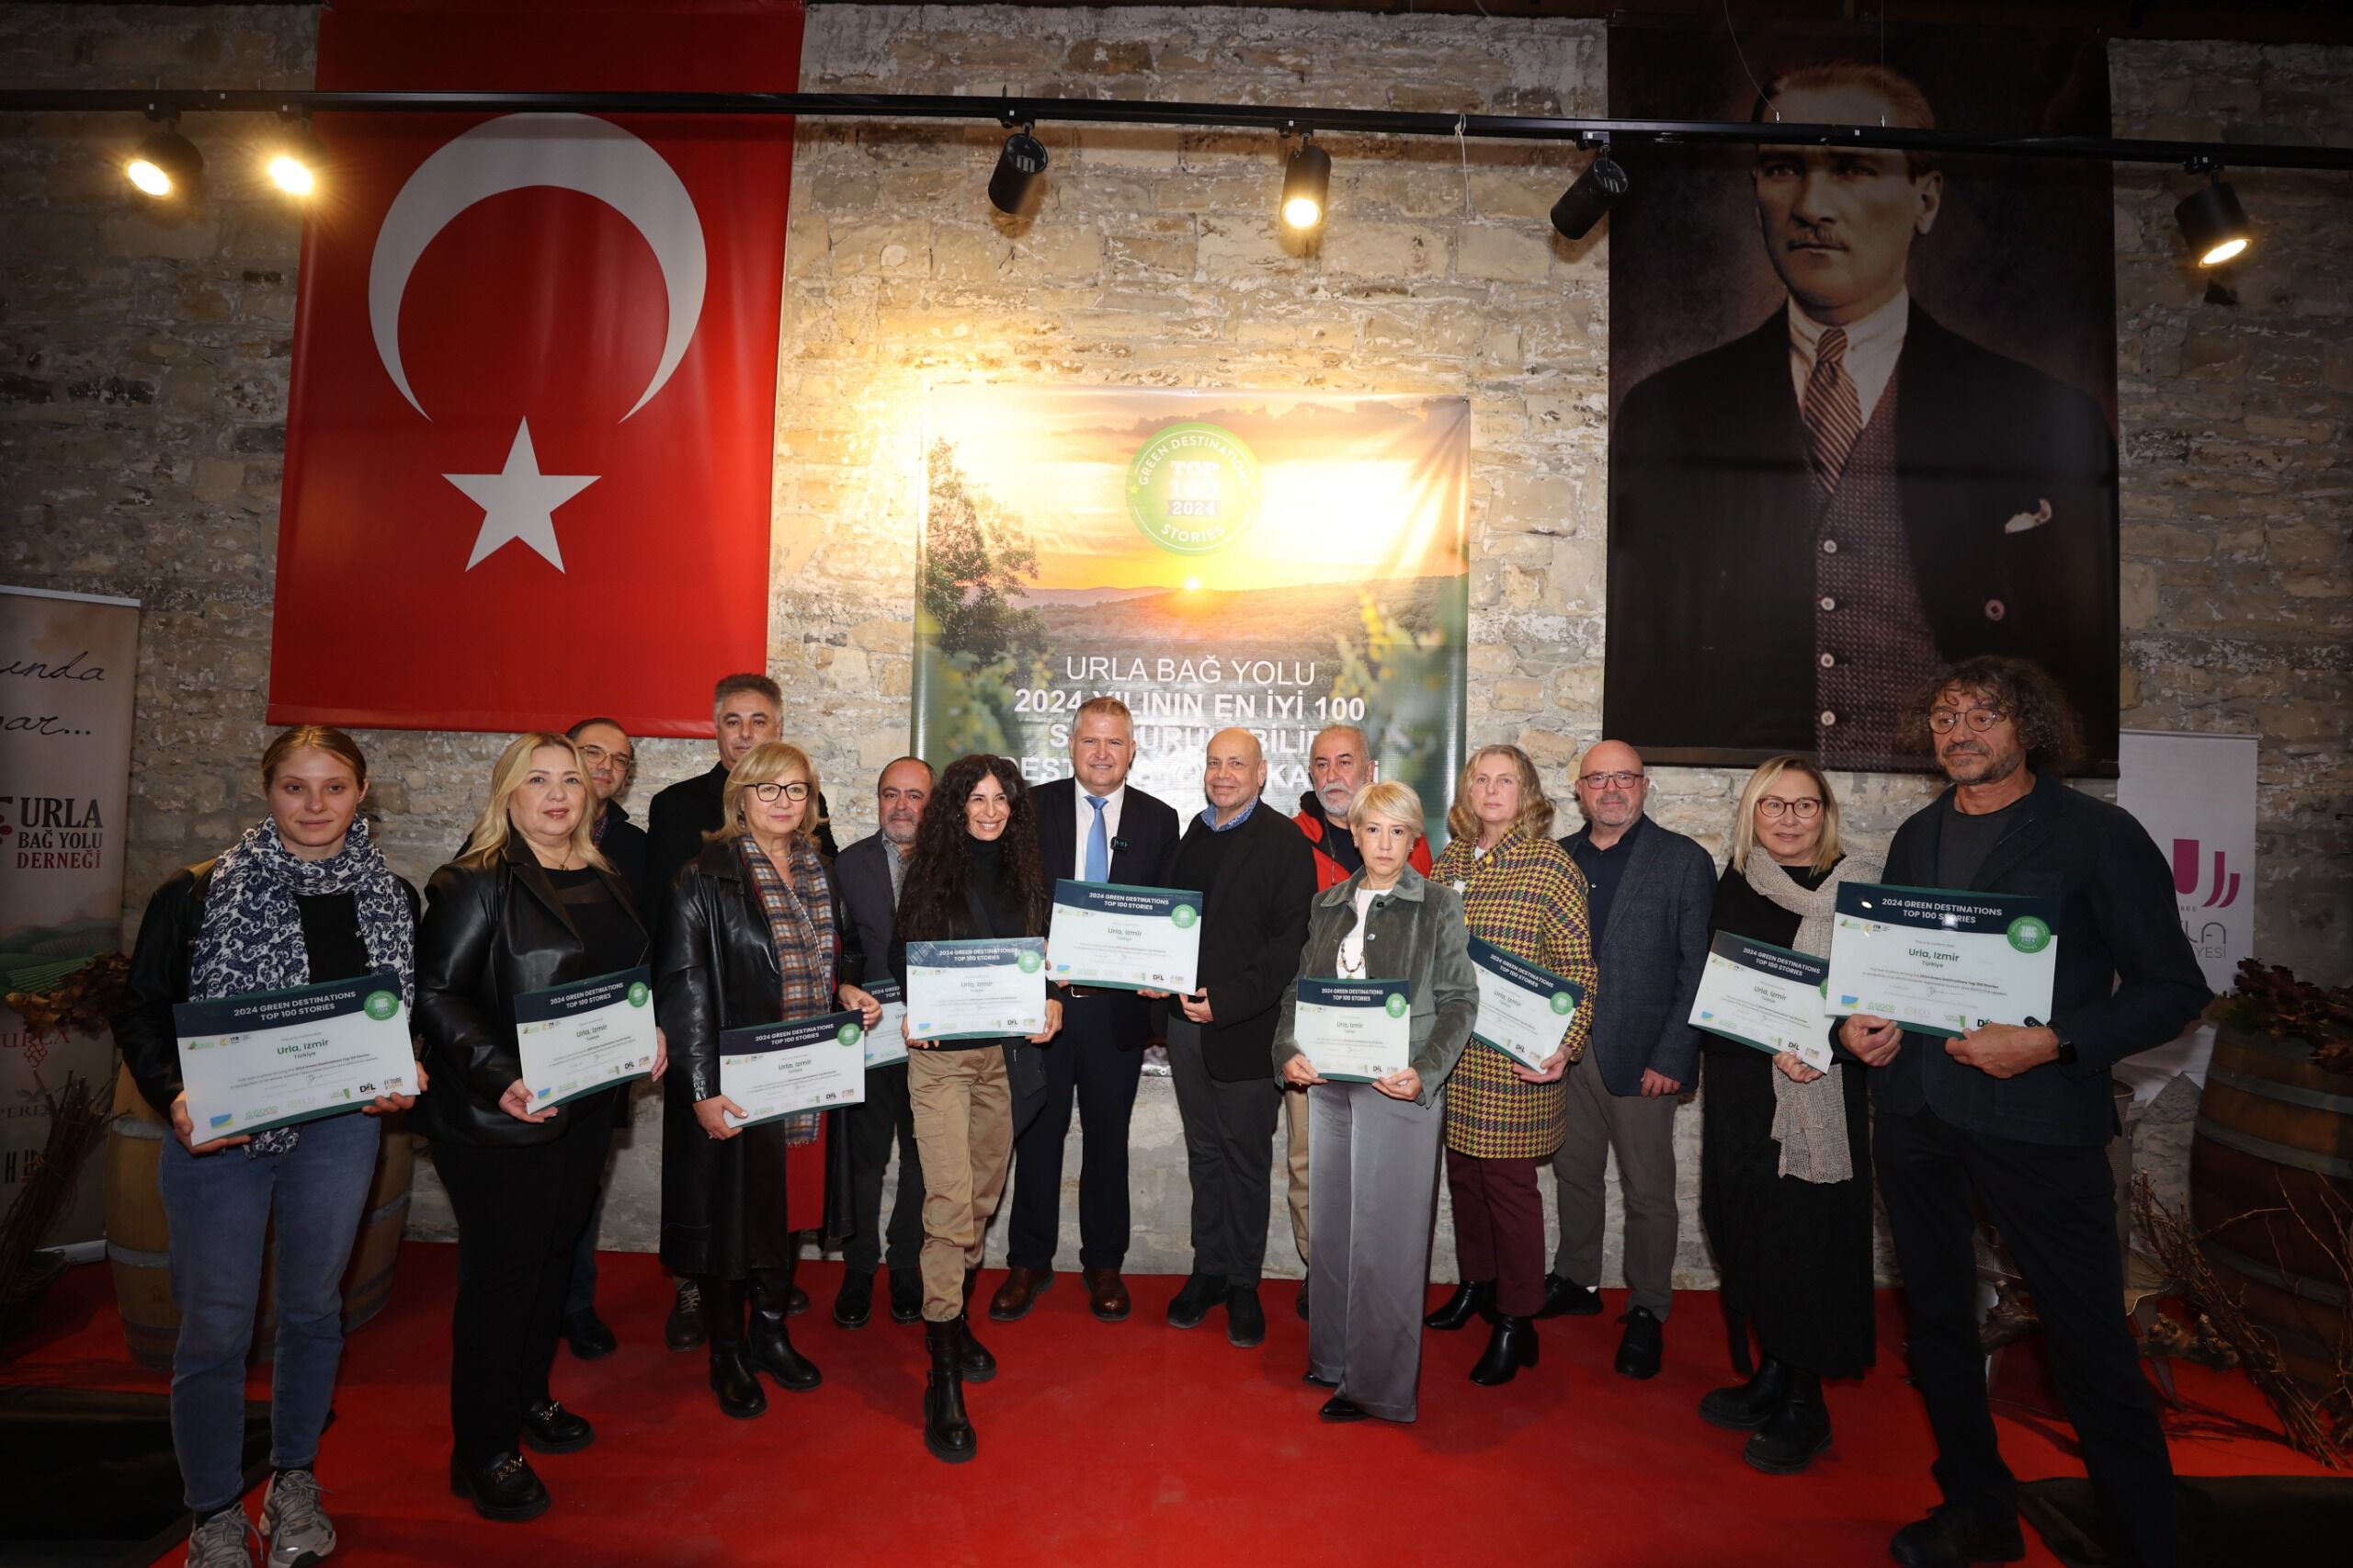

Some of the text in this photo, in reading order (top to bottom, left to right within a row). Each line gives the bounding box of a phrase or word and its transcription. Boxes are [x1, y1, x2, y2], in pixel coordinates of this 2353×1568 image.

[1139, 436, 1250, 487] GREEN DESTINATIONS
[1170, 460, 1221, 476] TOP
[1172, 501, 1216, 516] 2024
[1162, 523, 1225, 543] STORIES
[1065, 654, 1315, 687] URLA BAĞ YOLU
[1014, 688, 1082, 713] 2024
[1215, 694, 1256, 719] EN
[1267, 689, 1304, 720] İYİ
[1315, 697, 1366, 722] 100
[0, 716, 90, 735] ar...
[20, 797, 103, 828] URLA
[17, 830, 103, 848] BAĞ YOLU
[17, 850, 101, 869] DERNEĞİ
[1126, 896, 1169, 904] DESTINATIONS
[1882, 898, 2002, 915] 2024 GREEN DESTINATIONS
[1904, 910, 1920, 918] TOP
[1757, 952, 1777, 961] GREEN
[1777, 958, 1821, 974] DESTINATIONS
[1909, 949, 1931, 959] Urla,
[1490, 954, 1554, 988] 2024 GREEN DESTINATIONS
[1779, 965, 1802, 976] STORIES
[1518, 974, 1539, 987] STORIES
[551, 983, 623, 1006] 2024 GREEN DESTINATIONS
[589, 994, 610, 1004] STORIES
[234, 991, 357, 1017] 2024 GREEN DESTINATIONS
[260, 1003, 335, 1021] TOP 100 STORIES
[792, 1024, 835, 1035] DESTINATIONS
[795, 1032, 819, 1041] STORIES
[277, 1045, 301, 1055] Urla,
